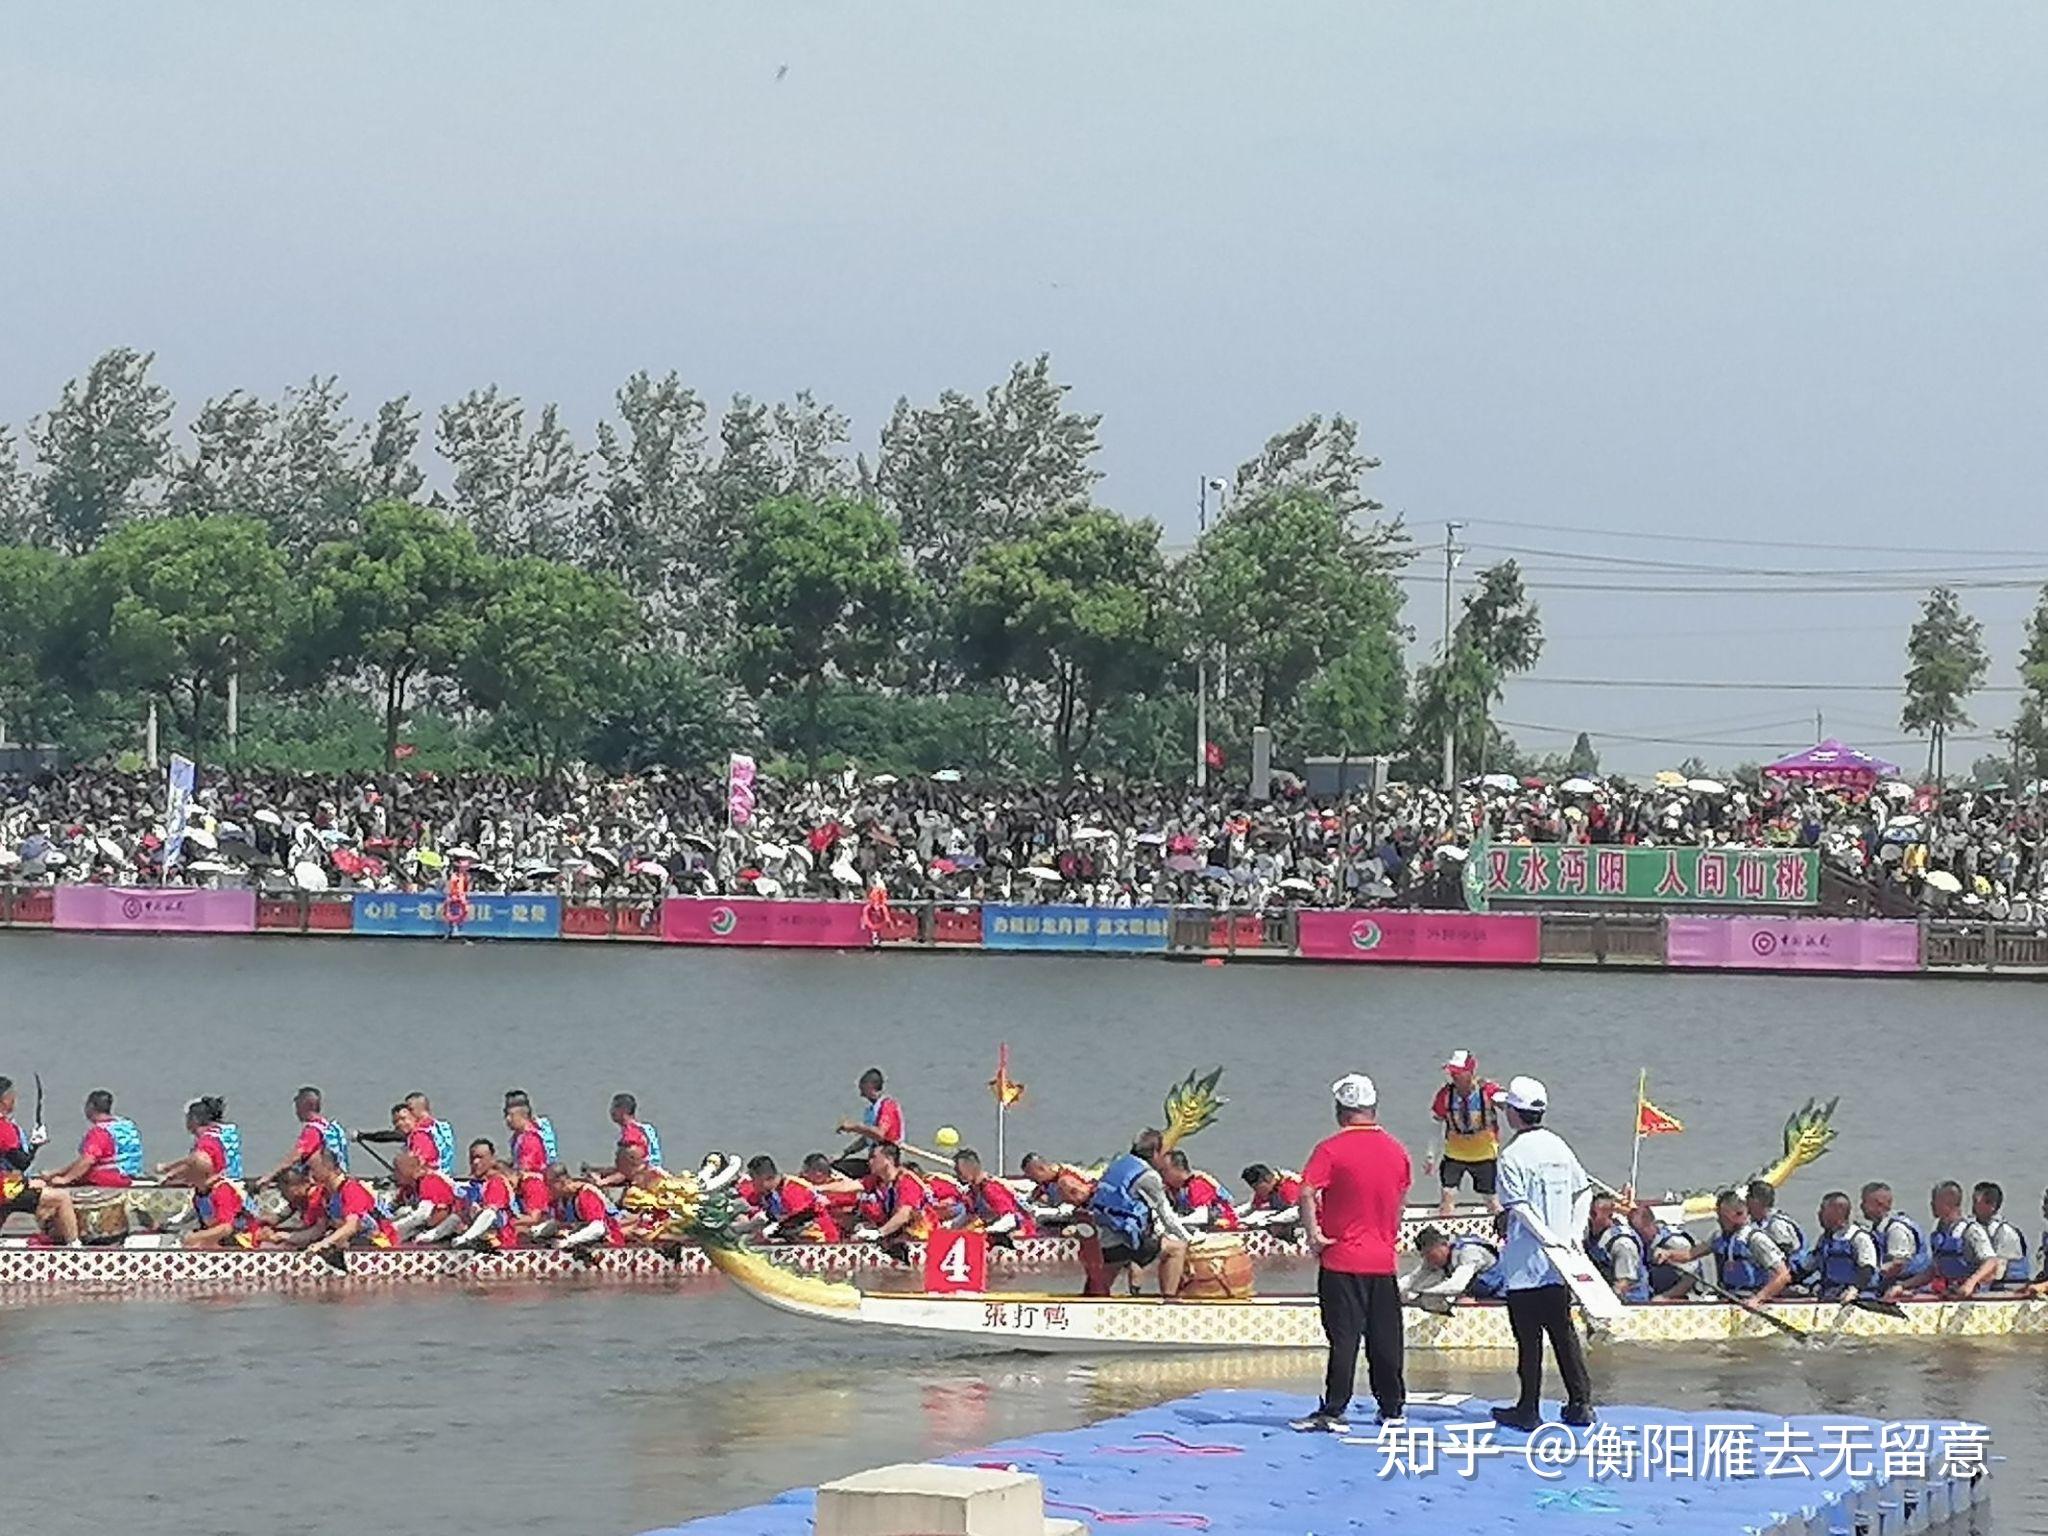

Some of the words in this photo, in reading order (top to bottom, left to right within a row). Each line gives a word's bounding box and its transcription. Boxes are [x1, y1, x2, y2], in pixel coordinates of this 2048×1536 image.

[1654, 850, 1808, 901] 人间仙桃
[940, 1236, 971, 1282] 4
